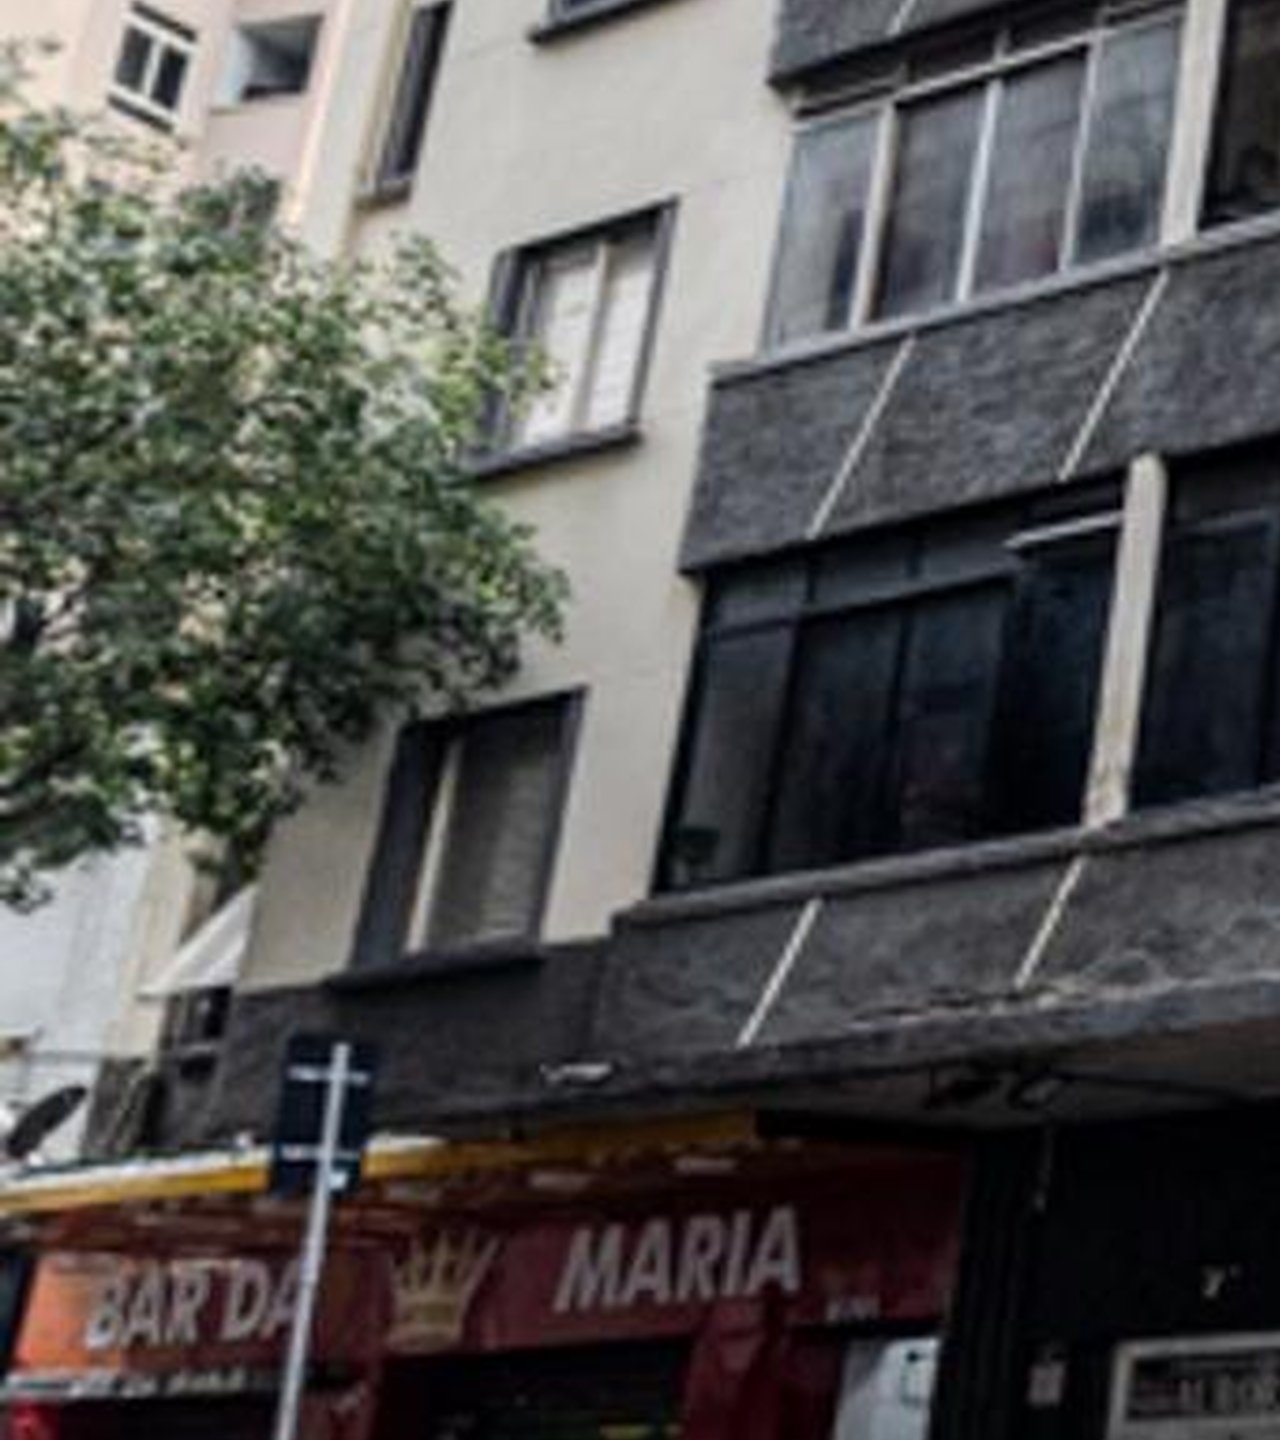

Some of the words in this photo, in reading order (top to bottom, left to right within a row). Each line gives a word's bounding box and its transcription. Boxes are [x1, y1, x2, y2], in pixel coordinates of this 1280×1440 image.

[84, 1257, 211, 1350] BAR
[217, 1256, 310, 1344] DA
[552, 1206, 800, 1313] MARIA
